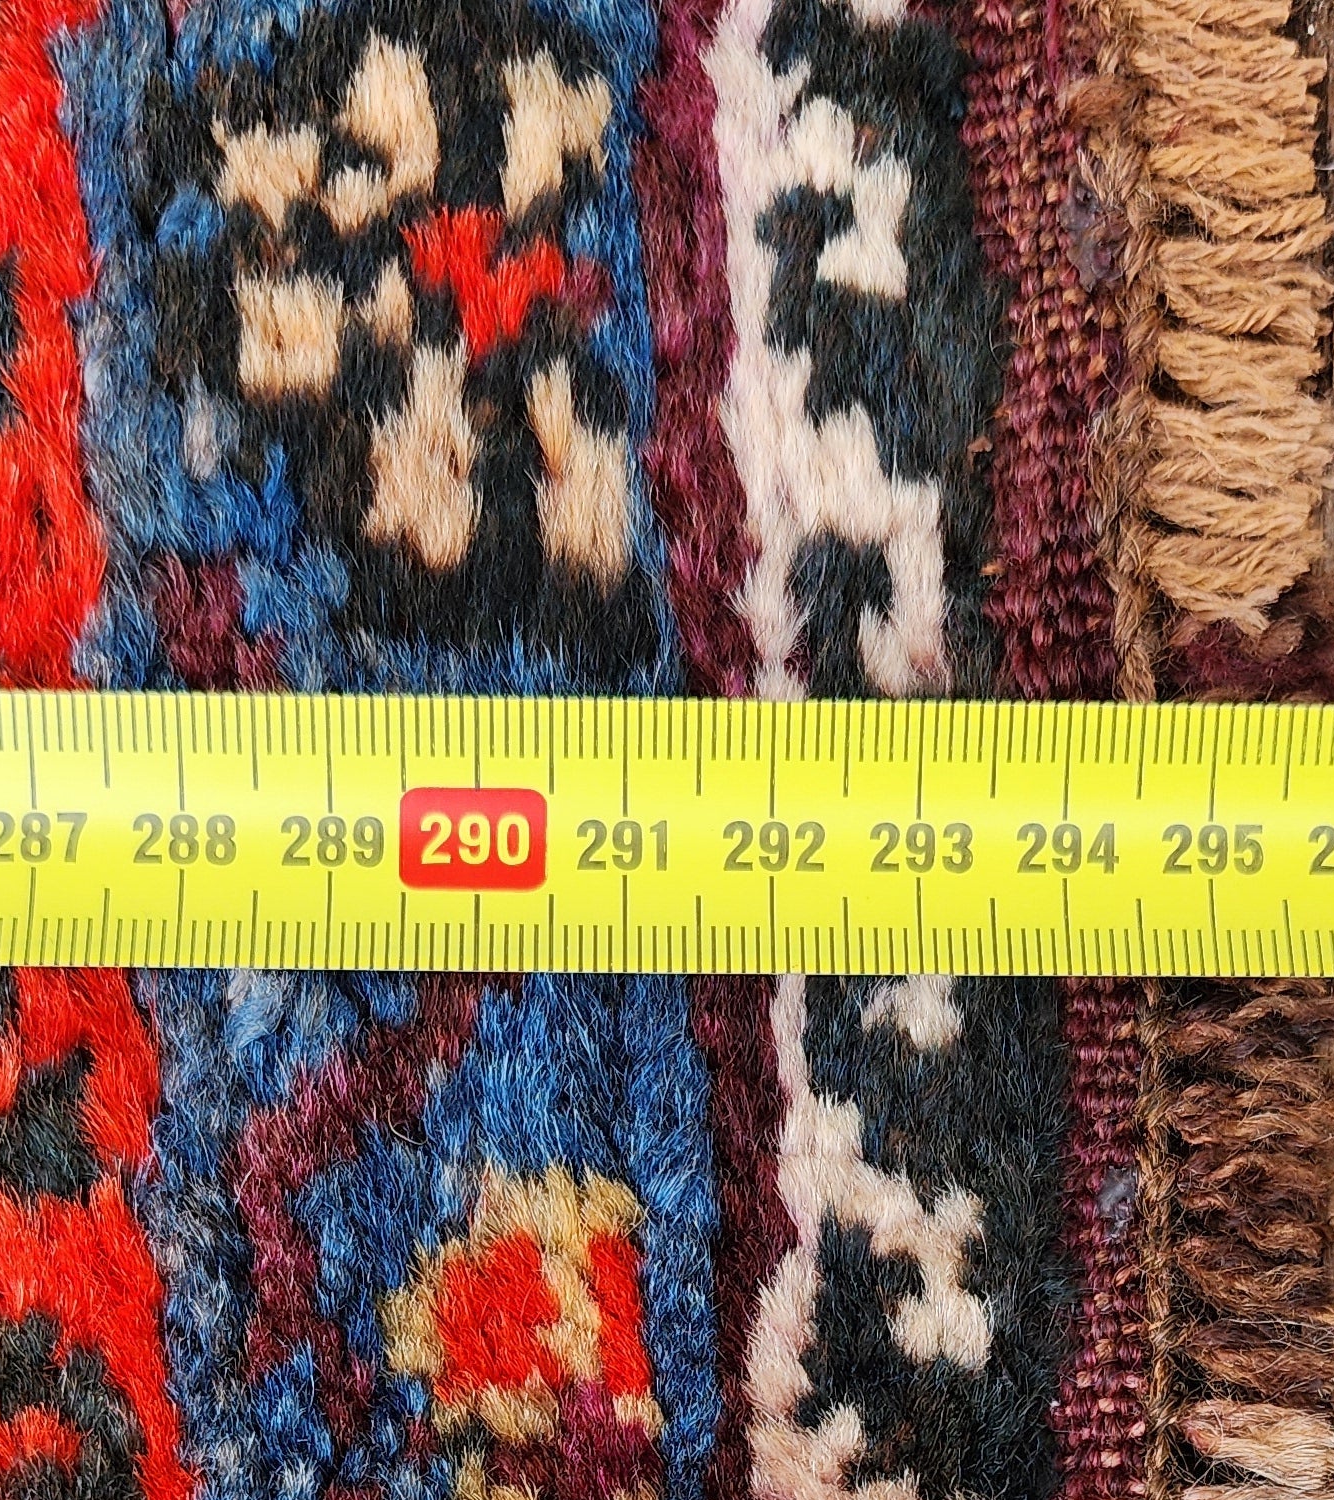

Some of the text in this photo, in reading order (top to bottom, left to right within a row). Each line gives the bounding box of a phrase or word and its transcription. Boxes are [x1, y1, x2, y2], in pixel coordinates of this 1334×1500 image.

[134, 814, 236, 864] 288
[282, 816, 384, 866] 289
[420, 813, 530, 866] 290
[577, 820, 667, 870] 291
[723, 821, 825, 871] 292
[870, 823, 973, 873] 293
[1017, 823, 1119, 873] 294
[1163, 825, 1263, 873] 295
